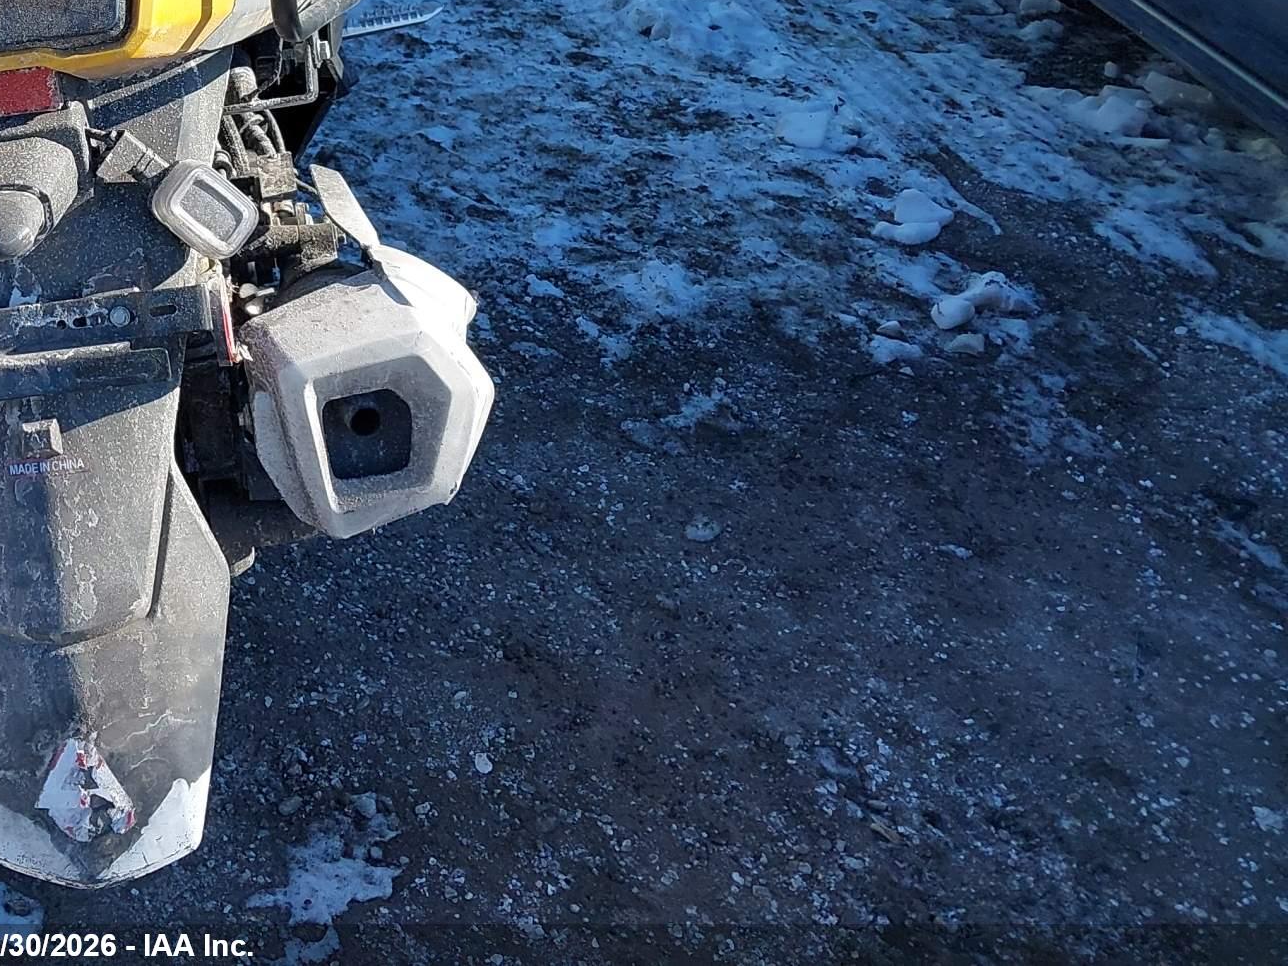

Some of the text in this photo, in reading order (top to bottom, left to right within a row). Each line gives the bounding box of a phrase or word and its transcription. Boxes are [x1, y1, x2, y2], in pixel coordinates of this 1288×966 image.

[9, 457, 85, 475] MADE IN CHINA
